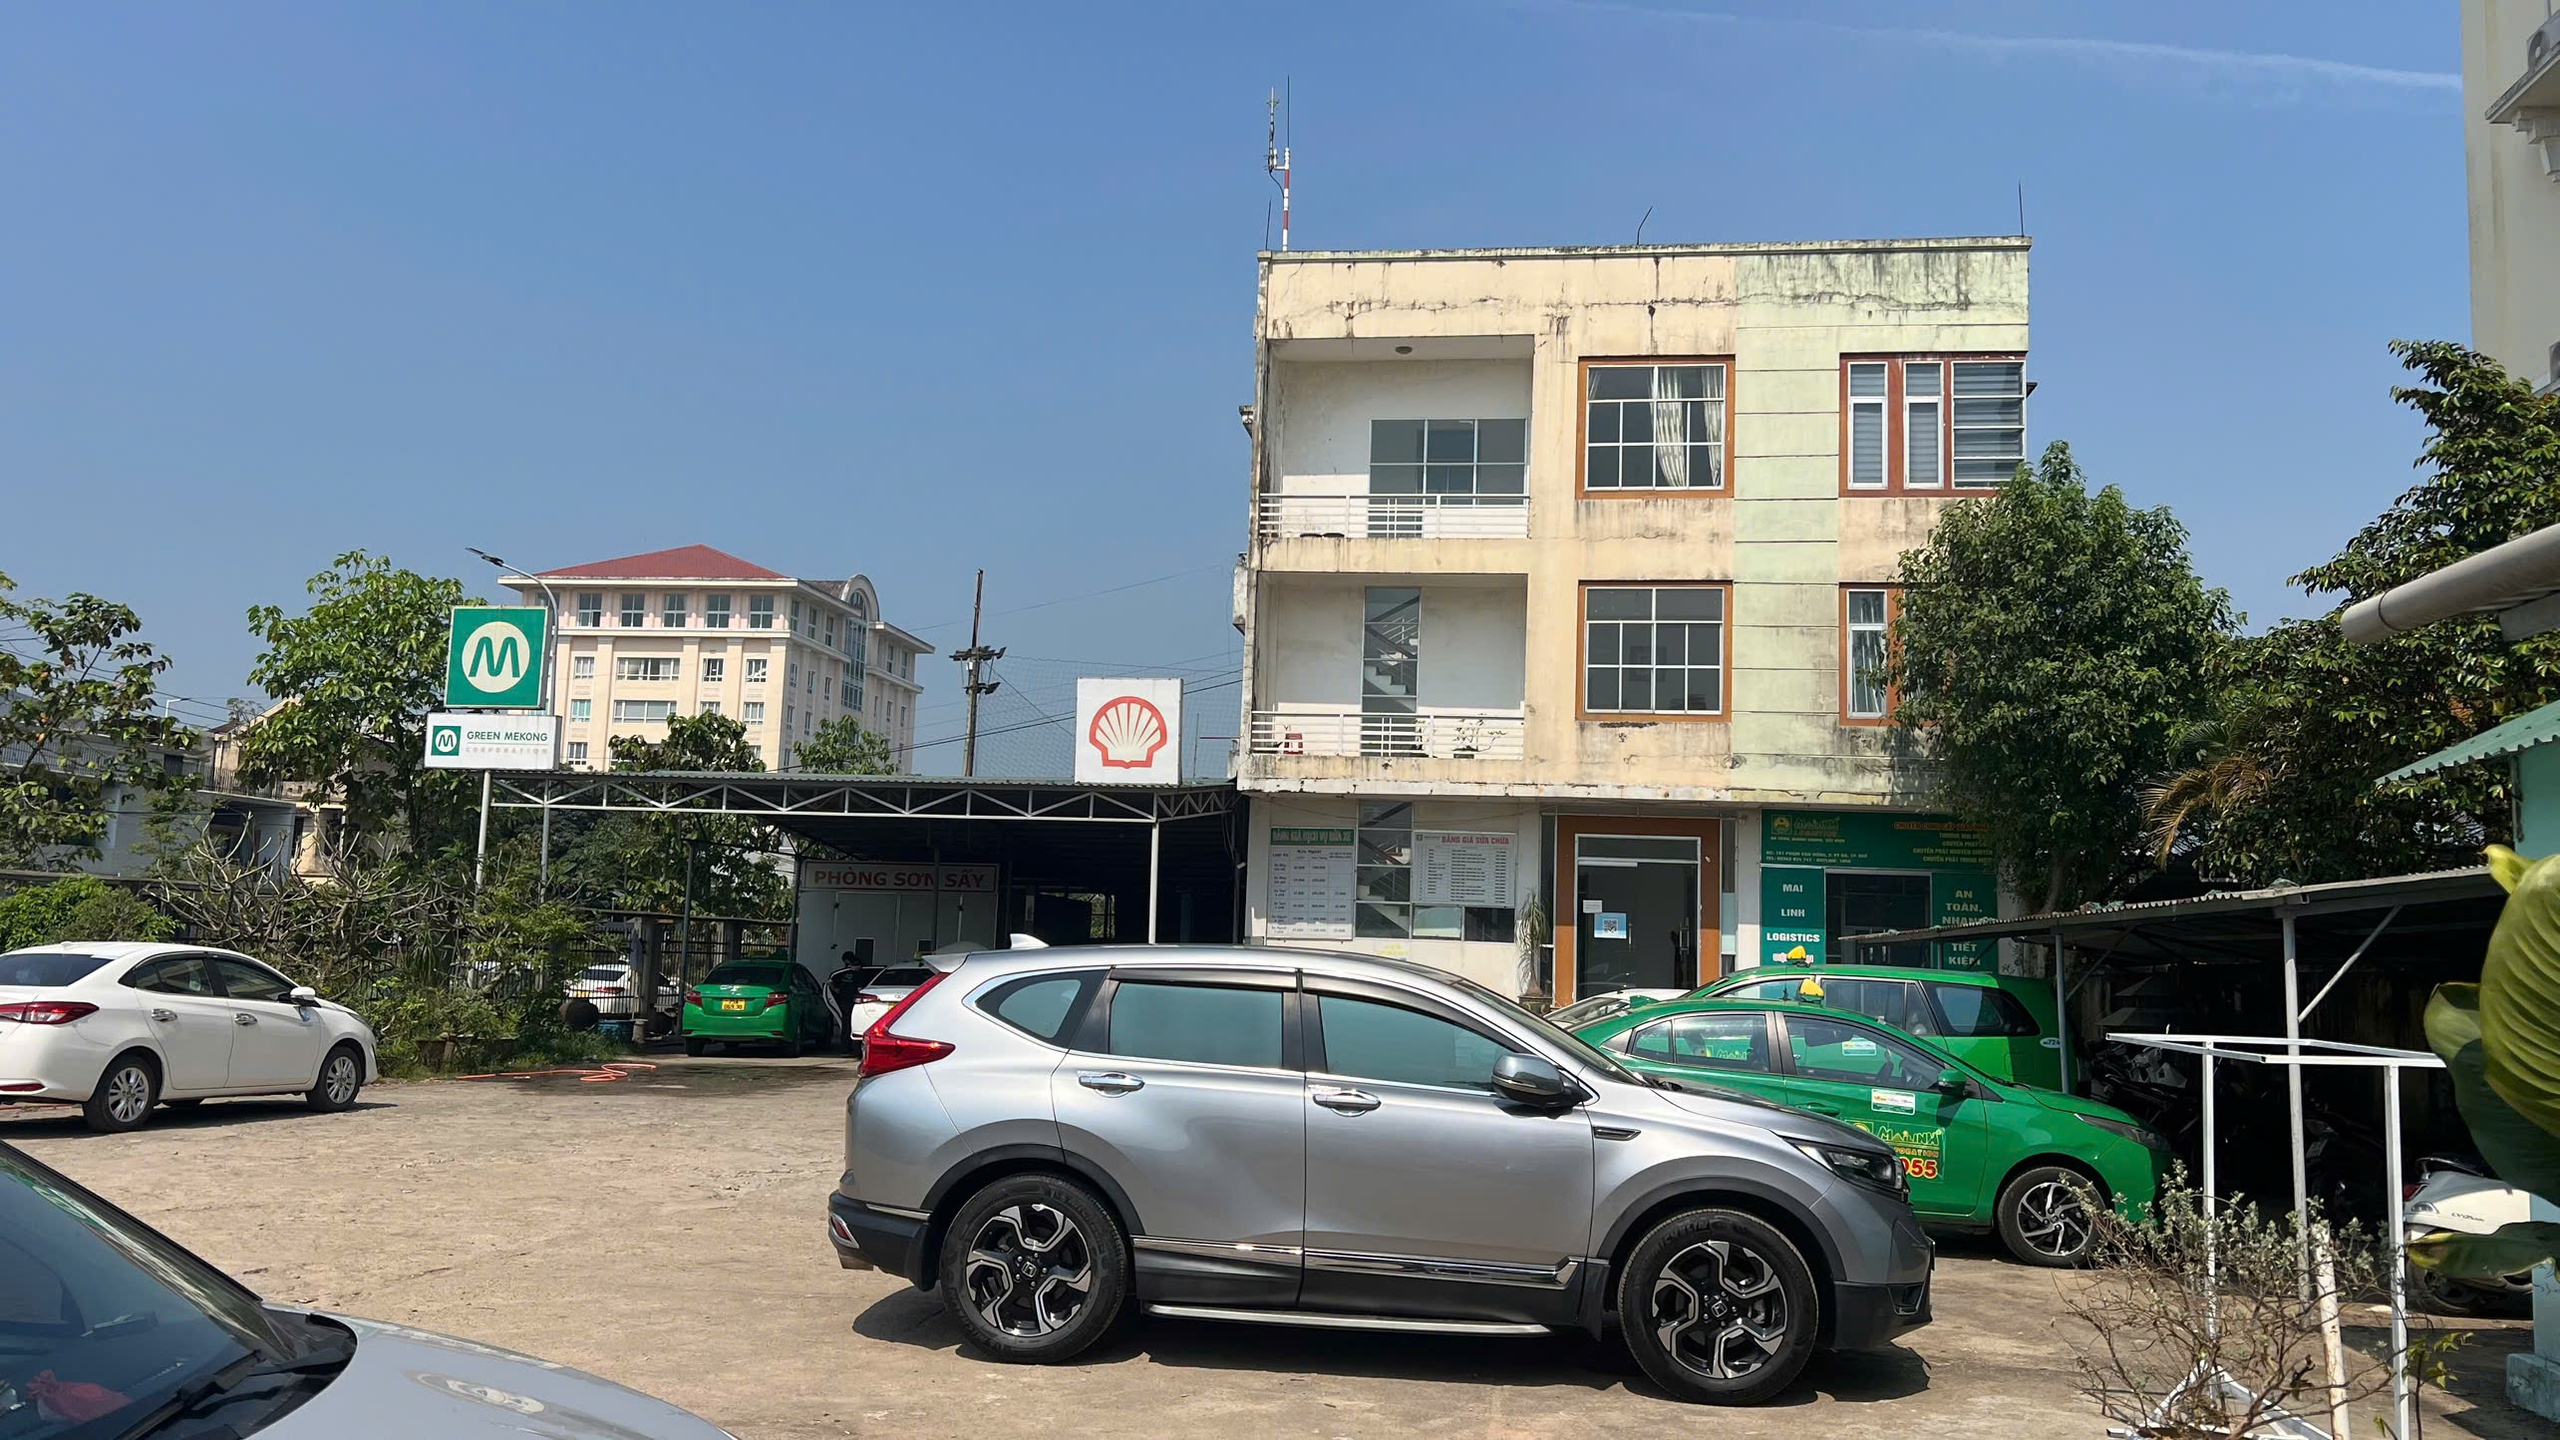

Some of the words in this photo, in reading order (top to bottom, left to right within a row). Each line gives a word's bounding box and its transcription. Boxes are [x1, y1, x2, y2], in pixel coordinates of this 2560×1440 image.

[466, 730, 500, 740] GREEN
[504, 731, 548, 742] MEKONG
[1442, 834, 1460, 844] BẢNG
[1462, 835, 1474, 844] GIÁ
[814, 866, 887, 886] PHÒNG
[894, 872, 936, 887] SƠN
[945, 869, 985, 888] SẤY
[1782, 884, 1803, 892] MAI
[1955, 890, 1973, 898] AN
[1781, 909, 1805, 917] LINH
[1766, 933, 1820, 943] LOGISTICS
[1951, 942, 1977, 952] TIẾT
[1898, 1158, 1938, 1178] 055
